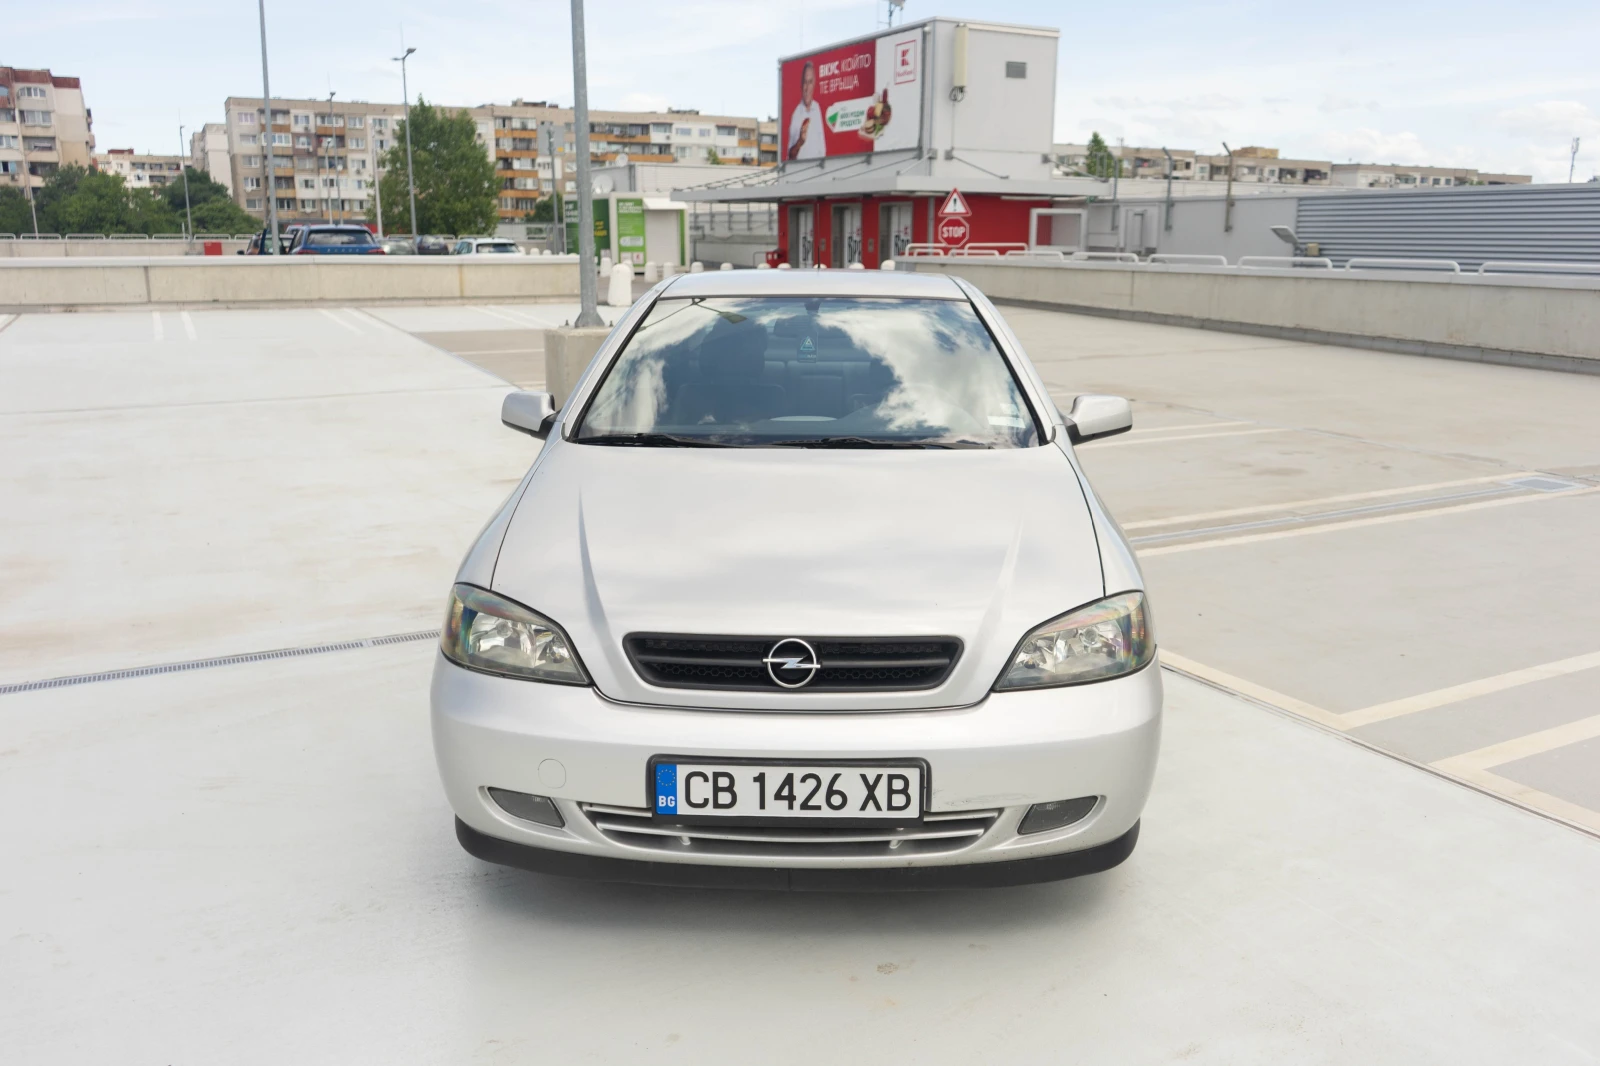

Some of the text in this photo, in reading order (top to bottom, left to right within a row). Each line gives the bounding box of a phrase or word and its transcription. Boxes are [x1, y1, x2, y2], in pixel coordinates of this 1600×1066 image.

[841, 54, 872, 72] КОЙТО
[819, 74, 860, 94] ТЕ ВРЪЩА
[942, 226, 966, 238] STOP
[684, 771, 912, 812] CB 1426 XB
[658, 796, 676, 807] BG
